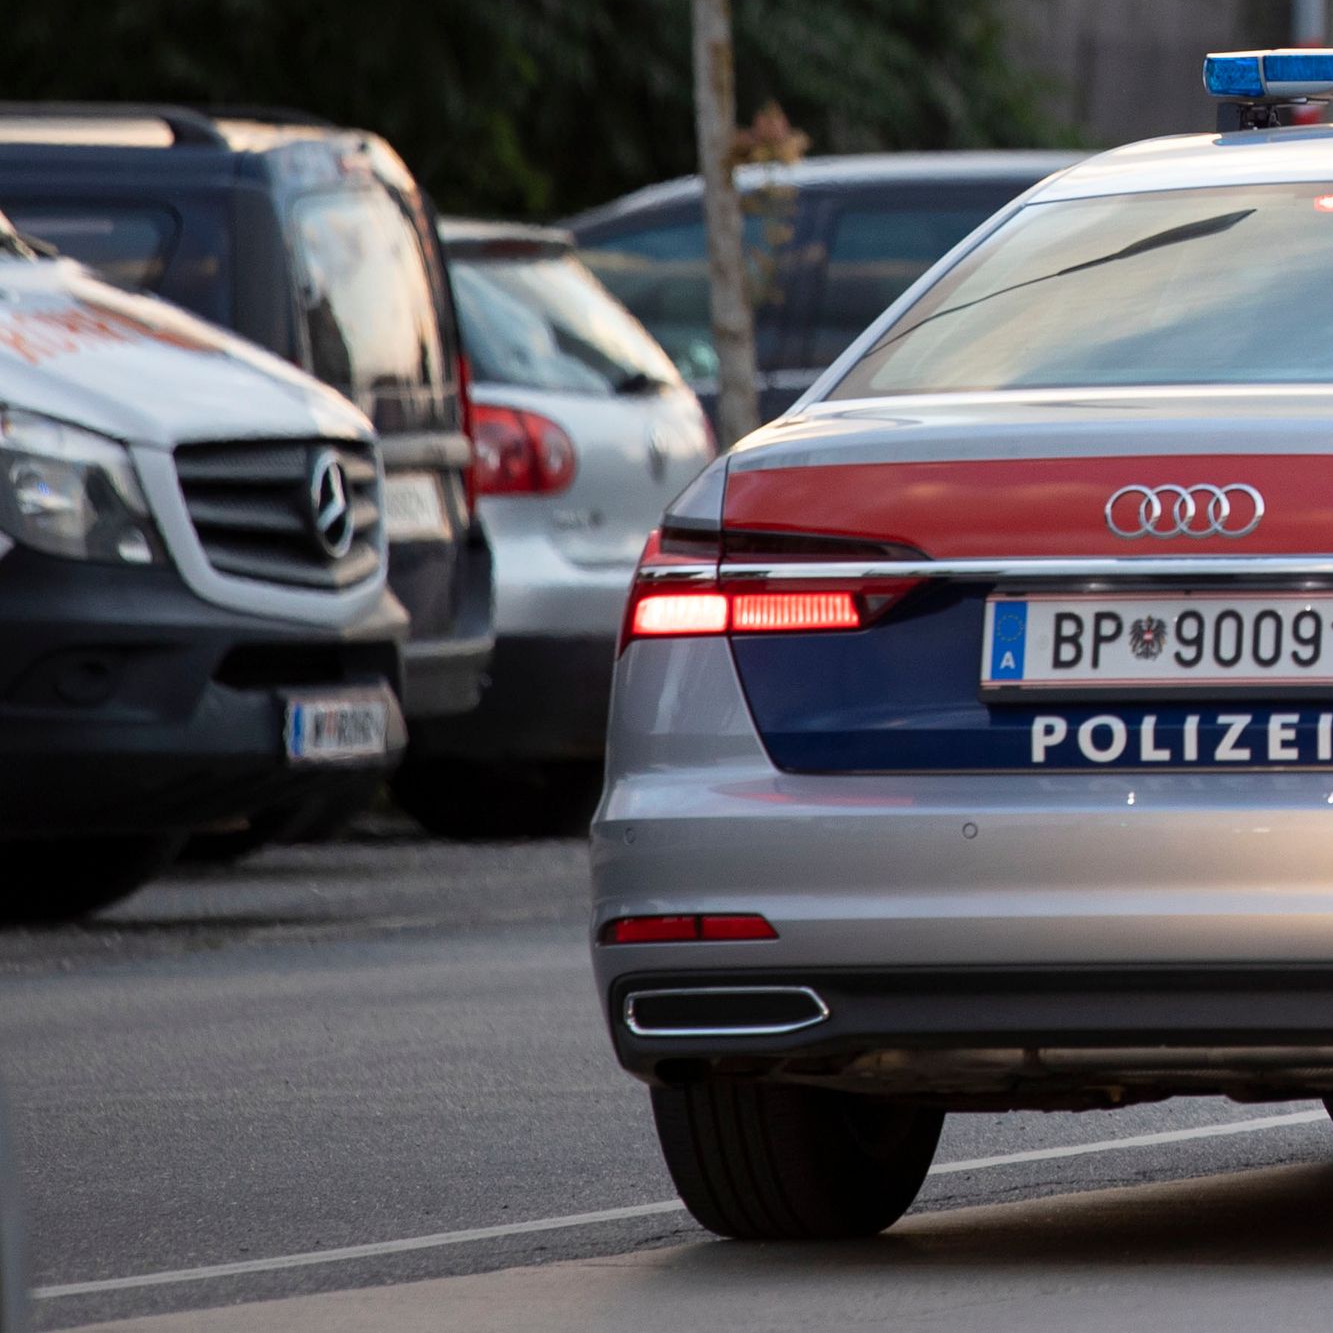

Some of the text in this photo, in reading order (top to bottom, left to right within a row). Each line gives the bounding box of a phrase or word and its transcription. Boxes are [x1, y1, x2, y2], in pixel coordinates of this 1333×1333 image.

[1000, 651, 1015, 669] A
[1052, 611, 1124, 669] BP
[1031, 712, 1333, 763] POLIZEI
